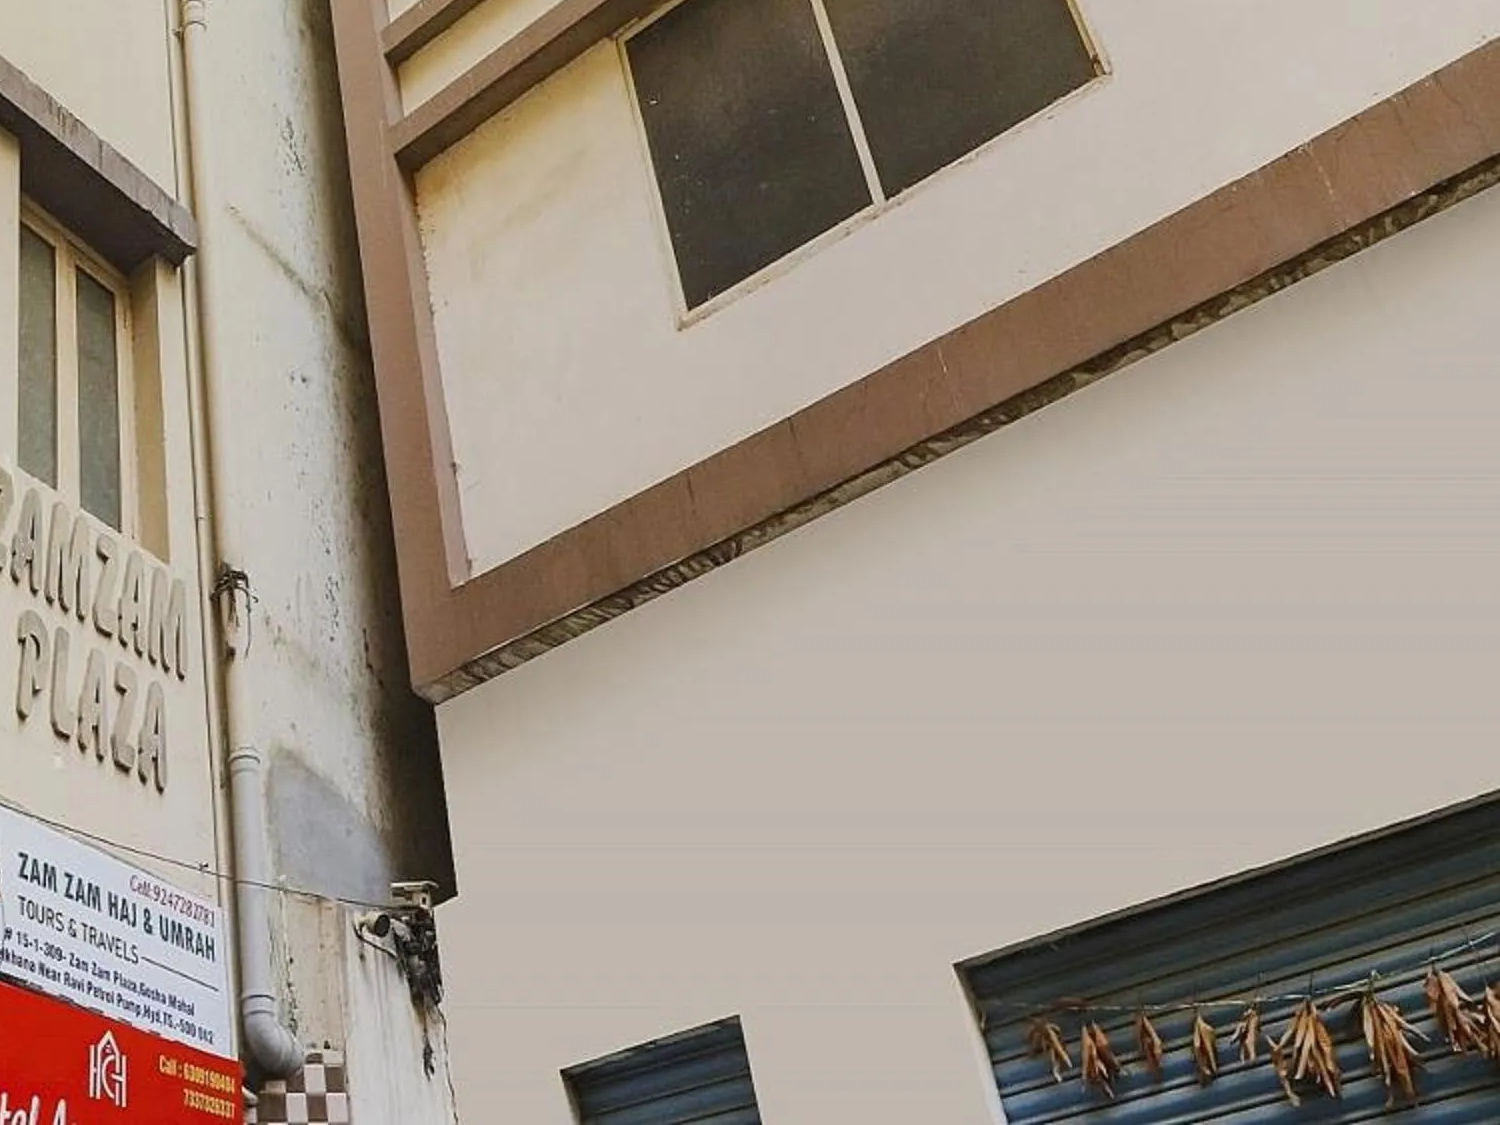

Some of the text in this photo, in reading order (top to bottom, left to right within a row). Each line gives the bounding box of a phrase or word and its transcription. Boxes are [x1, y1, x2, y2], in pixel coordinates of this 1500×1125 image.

[16, 609, 168, 796] PLAZA
[17, 895, 139, 964] TOURS & TRAVELS
[18, 852, 216, 963] ZAM ZAM HAJ & UMRAH
[38, 961, 61, 984] Near
[63, 970, 85, 993] Ravi
[86, 980, 115, 1005] Petrol
[68, 951, 89, 972] Zam
[159, 1054, 177, 1075] Call
